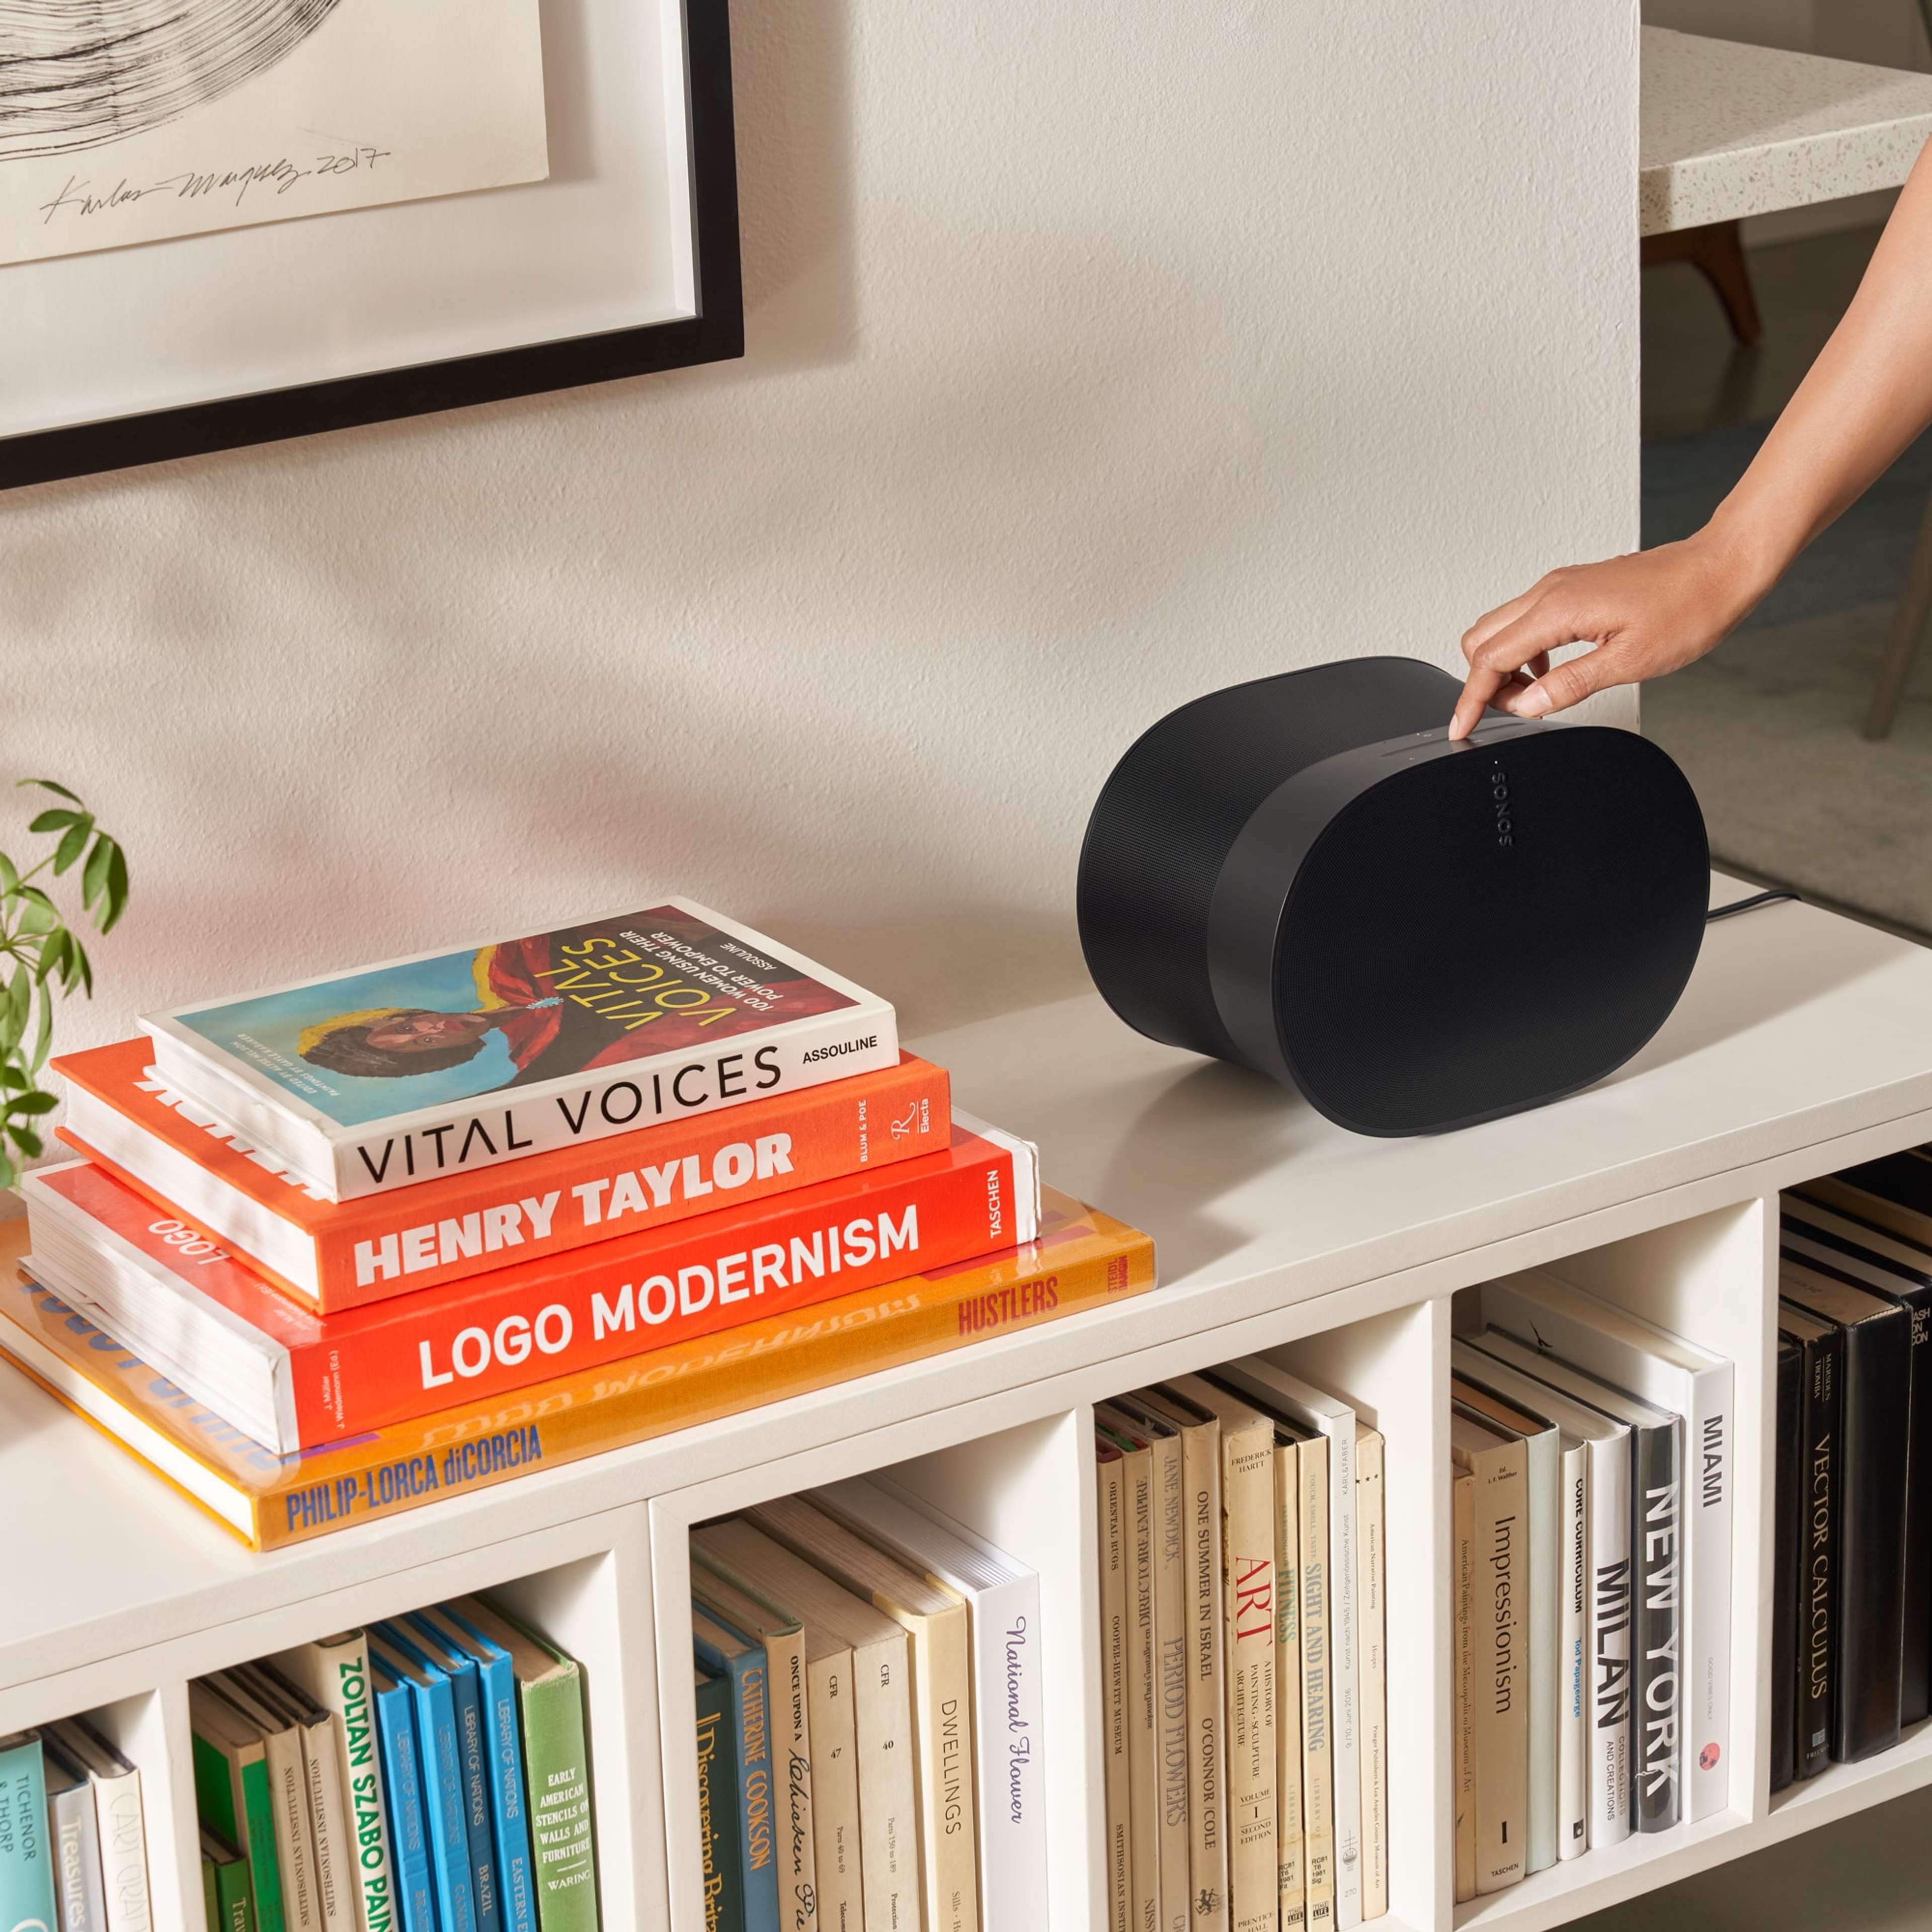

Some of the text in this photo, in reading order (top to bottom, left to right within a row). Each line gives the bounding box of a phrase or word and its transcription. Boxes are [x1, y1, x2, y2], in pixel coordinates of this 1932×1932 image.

[316, 147, 391, 174] 2017
[1492, 772, 1513, 846] SONOS
[560, 938, 737, 1026] VOICES
[619, 931, 774, 1011] 100 WOMEN USING THEIR
[651, 932, 783, 1000] POWER TO EMPOWER
[720, 942, 777, 971] ASSOULINE
[533, 958, 664, 1030] VITAL
[802, 1035, 877, 1065] ASSOULINE
[358, 1110, 532, 1183] VITAL
[556, 1046, 781, 1135] VOICES
[858, 1099, 868, 1163] BLUM & POE
[920, 1098, 929, 1134] Electa
[354, 1133, 794, 1287] HENRY TAYLOR
[990, 1169, 1000, 1239] TASCHEN
[148, 1219, 232, 1265] LOGO
[1108, 1258, 1117, 1294] STEIDL
[419, 1304, 573, 1390] LOGO
[591, 1204, 920, 1341] MODERNISM
[958, 1275, 1059, 1337] HUSTLERS
[329, 1350, 340, 1372] (Ed.)
[286, 1424, 542, 1532] PHILIP-LORCA diCORCIA
[1231, 1450, 1272, 1466] FREDERICK
[1239, 1460, 1265, 1473] HARTT
[1499, 1466, 1507, 1474] Ed.
[1703, 1414, 1723, 1508] MIAMI
[1109, 1481, 1118, 1571] ORIENTAL RUGS
[1164, 1456, 1180, 1562] JANE NEWDICK
[1461, 1539, 1470, 1583] American
[1575, 1478, 1584, 1614] CORE CURRICULUM
[1811, 1433, 1830, 1700] VECTOR CALCULUS
[1197, 1491, 1212, 1681] ONE SUMMER IN ISRAEL
[1236, 1556, 1273, 1647] ART
[1278, 1568, 1297, 1644] FITNESS
[1489, 1515, 1517, 1715] Impressionism
[1306, 1563, 1325, 1752] SIGHT AND HEARING
[1462, 1626, 1470, 1649] from
[1597, 1557, 1630, 1729] MILAN
[1646, 1480, 1679, 1798] NEW YORK
[790, 1655, 802, 1742] ONCE UPON A
[828, 1675, 838, 1699] CFR
[880, 1664, 890, 1687] CFR
[1112, 1616, 1122, 1755] COOPER-HEWITT MUSEUM
[1236, 1669, 1245, 1749] ARCHITECTURE
[1264, 1670, 1272, 1714] HISTORY
[1573, 1638, 1582, 1718] Tod Papageorge
[339, 1656, 373, 1767] ZOLTAN
[882, 1740, 894, 1750] 40
[1006, 1616, 1030, 1824] National Flower
[1163, 1637, 1186, 1827] PERIOD FLOWERS
[1251, 1663, 1260, 1781] PAINTING SCULPTURE
[1265, 1716, 1272, 1727] OF
[464, 1705, 485, 1826] LIBRARY OF NATIONS
[498, 1698, 519, 1819] LIBRARY OF NATIONS
[548, 1767, 576, 1786] EARLY
[741, 1668, 771, 1871] CATHERINE COOKSON
[830, 1748, 842, 1759] 47
[942, 1699, 961, 1835] DWELLINGS
[1201, 1718, 1215, 1803] O'CONNOR
[1464, 1778, 1472, 1793] Art
[1605, 1740, 1616, 1821] AND CREATIONS
[0, 1796, 15, 1854] THORP
[17, 1774, 37, 1862] TICHENOR
[352, 1777, 384, 1870] SZABO
[535, 1804, 579, 1827] STENCILS
[540, 1783, 585, 1808] AMERICAN
[1240, 1788, 1271, 1803] VOLUME
[1241, 1820, 1271, 1835] SECOND
[284, 1766, 310, 1926] SMITHSONIAN INSTITUTION
[309, 1758, 337, 1917] SMITHSONIAN INSTITUTION
[539, 1819, 589, 1846] WALLS AND
[542, 1837, 591, 1864] FURNITURE
[788, 1747, 816, 1932] Chicken Pie
[1116, 1823, 1125, 1897] SMITHSONIAN
[1240, 1830, 1272, 1845] EDITION
[1312, 1856, 1328, 1865] RC81
[61, 1815, 86, 1928] Treasures
[478, 1864, 493, 1917] BRAZIL
[511, 1857, 528, 1920] EASTERN
[547, 1870, 592, 1891] WARING
[839, 1864, 845, 1874] 69
[952, 1891, 960, 1912] Sills
[1344, 1888, 1356, 1898] 270
[1491, 1862, 1519, 1878] TASCHEN
[1247, 1920, 1268, 1932] HALL
